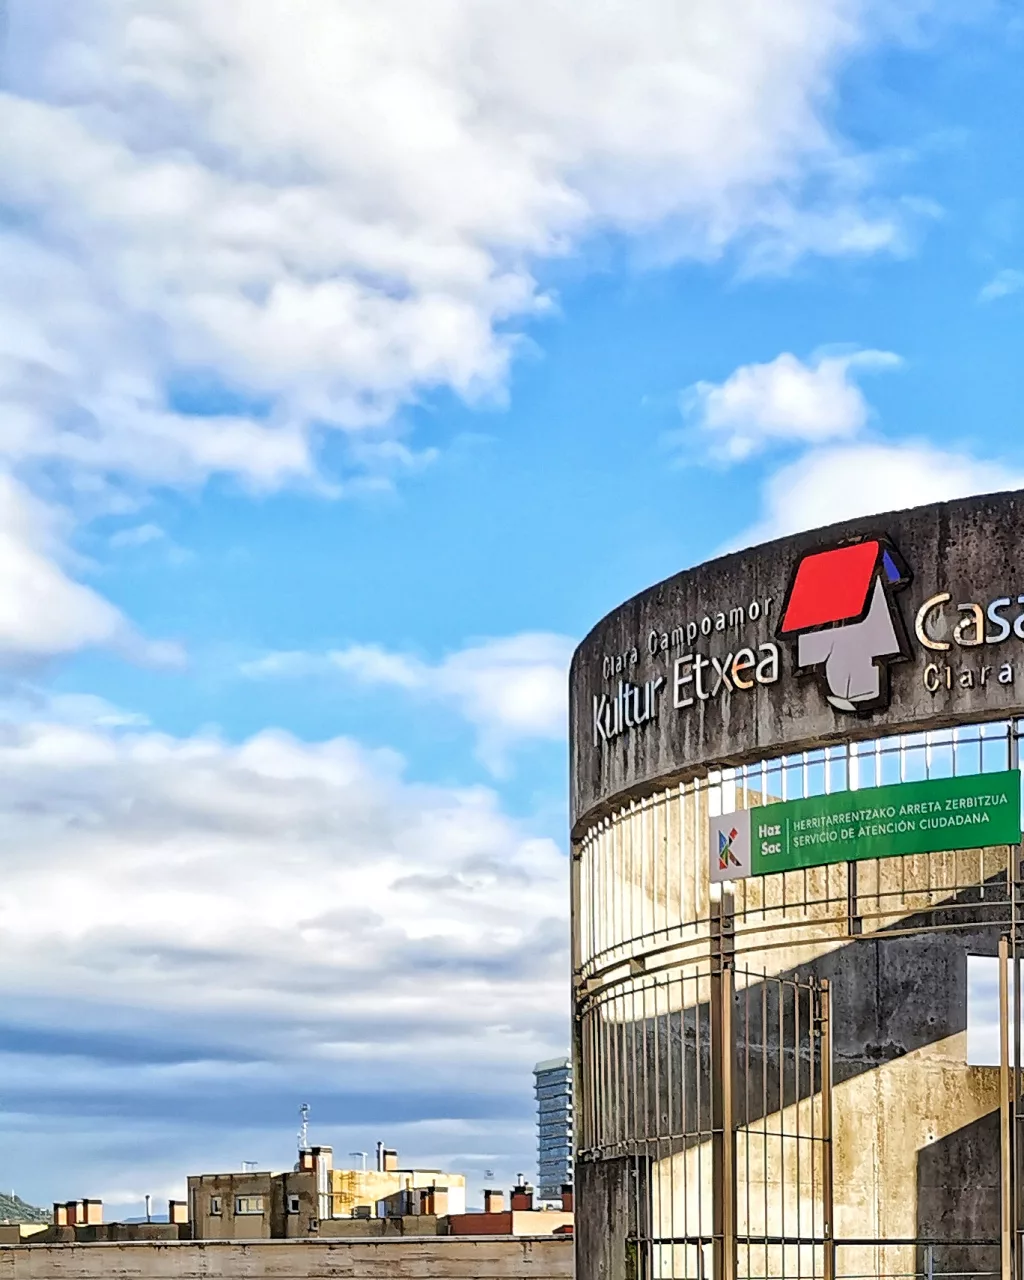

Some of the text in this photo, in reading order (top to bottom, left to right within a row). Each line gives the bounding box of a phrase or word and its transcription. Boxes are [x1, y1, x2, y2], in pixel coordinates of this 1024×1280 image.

[602, 597, 773, 680] Clara Campoamor
[592, 642, 780, 748] Kultur Etxea
[923, 662, 1014, 692] Clara
[793, 793, 1008, 832] HERRITARRENTZAKO ARRETA ZERBITZUA
[793, 812, 990, 848] SERVICIO DE ATENCIÓN CIUDADANA
[758, 823, 782, 839] Haz
[761, 841, 782, 856] Sac
